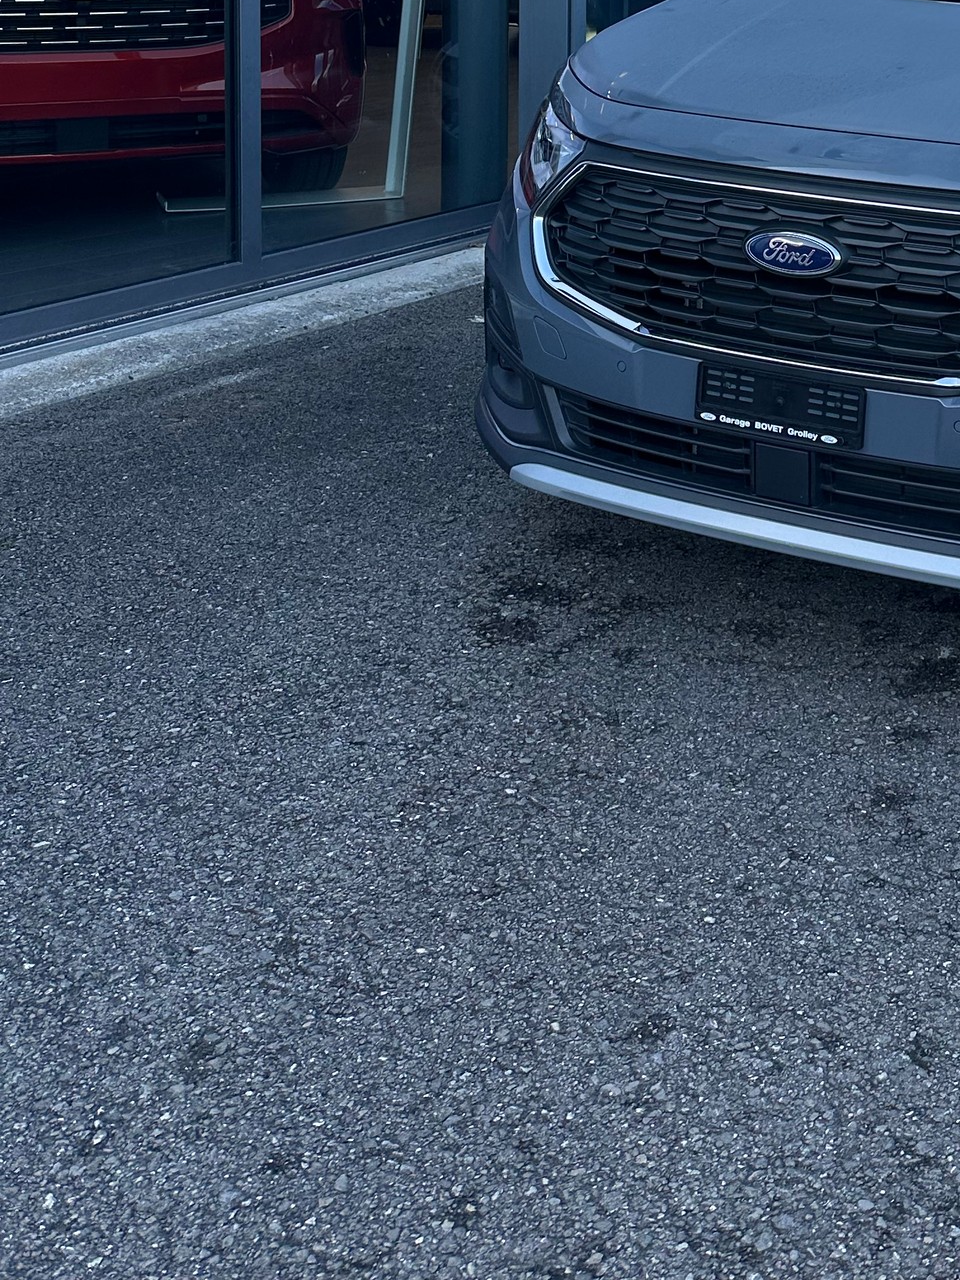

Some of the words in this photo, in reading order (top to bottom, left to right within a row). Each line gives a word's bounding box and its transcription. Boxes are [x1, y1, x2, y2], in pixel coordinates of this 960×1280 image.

[762, 236, 816, 267] Ford
[719, 414, 751, 428] Garage
[754, 421, 784, 434] BOVET
[787, 427, 818, 441] Grolley
